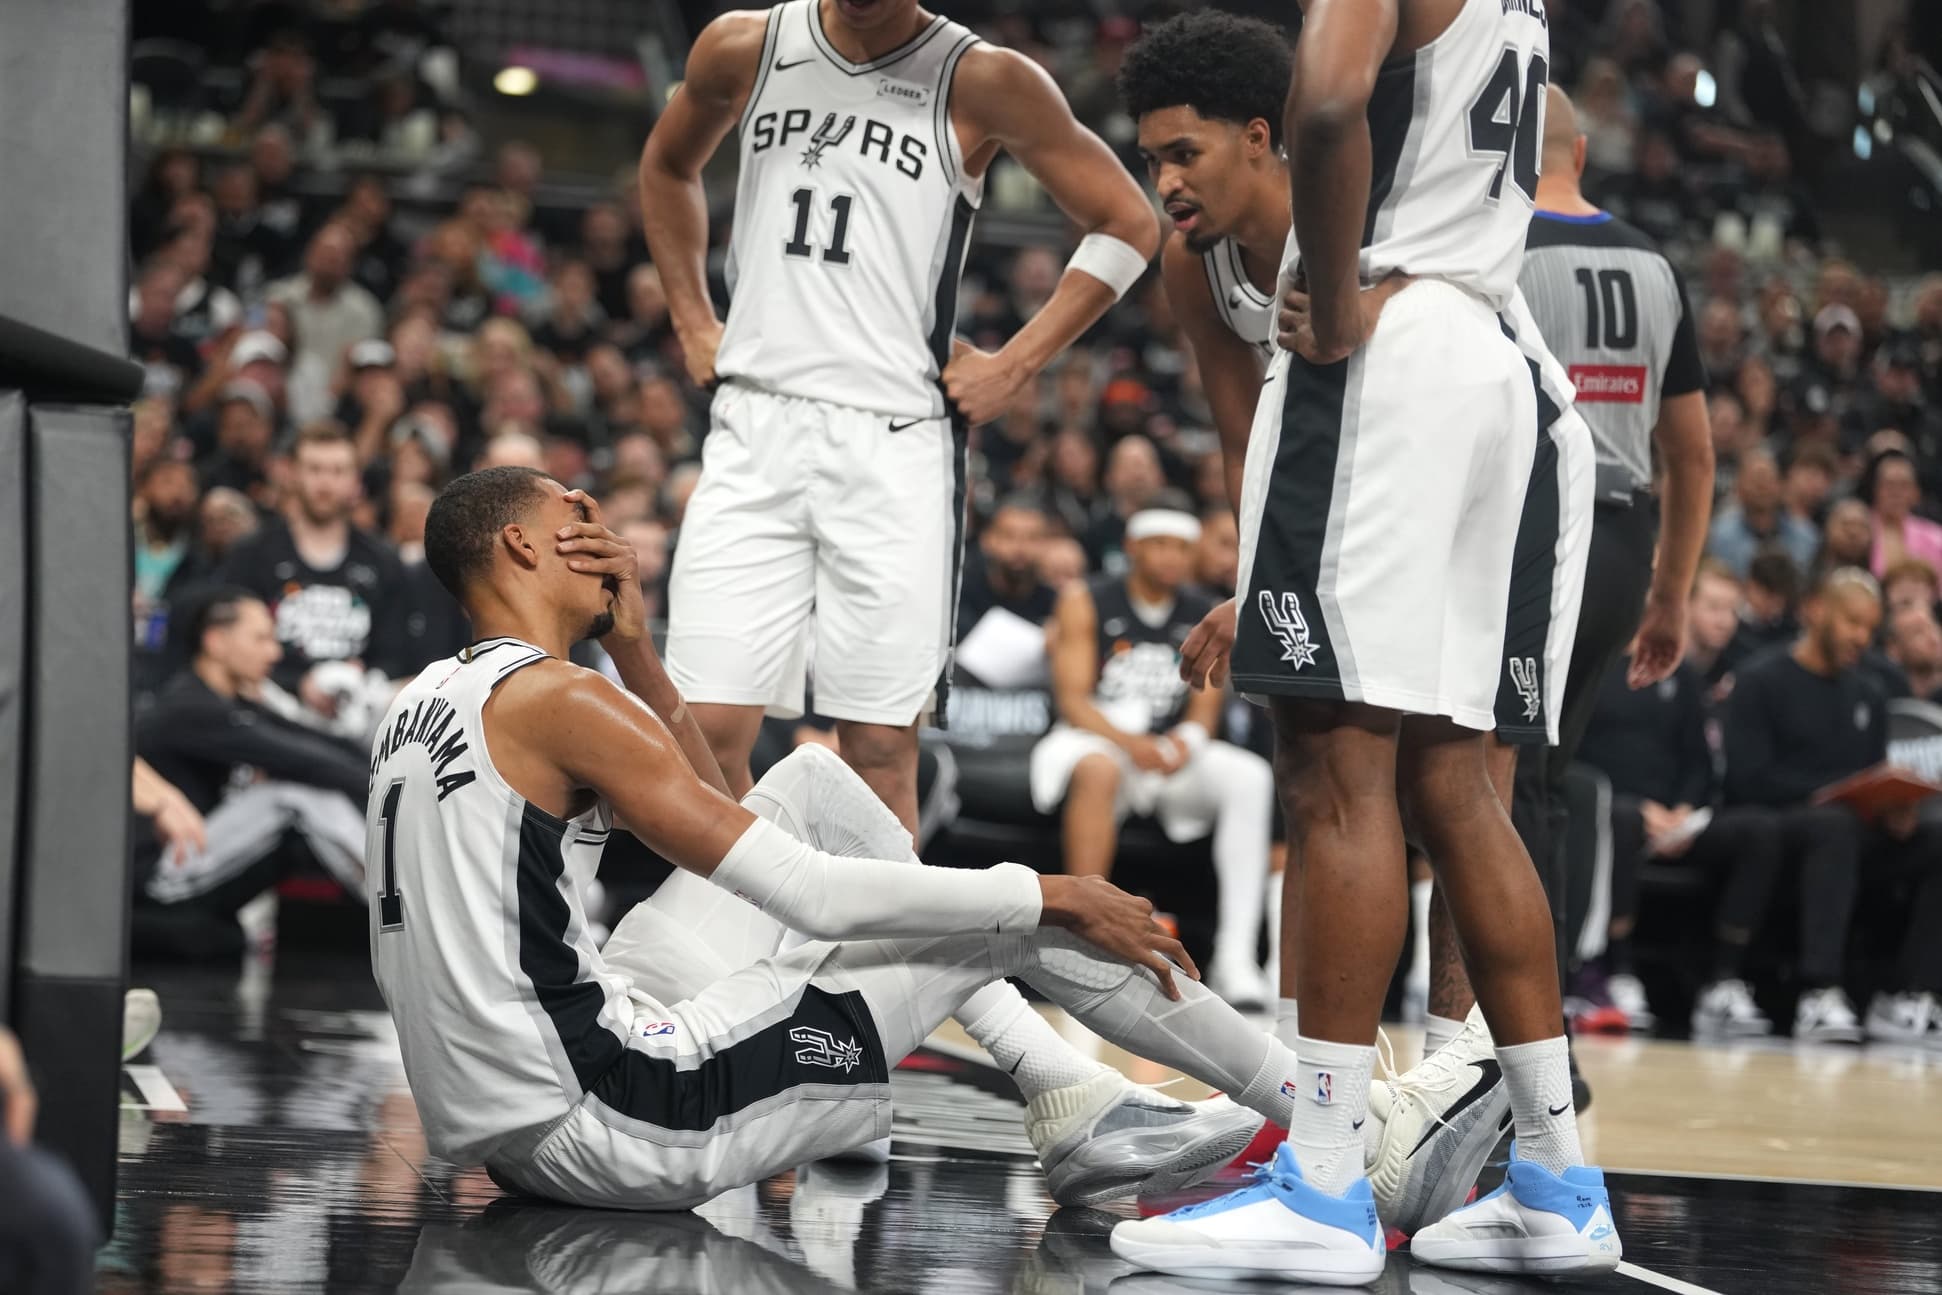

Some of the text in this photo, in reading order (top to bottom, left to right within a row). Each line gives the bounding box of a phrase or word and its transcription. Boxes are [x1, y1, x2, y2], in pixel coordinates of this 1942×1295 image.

[752, 109, 927, 181] SPURS
[784, 187, 853, 266] 11
[1575, 267, 1638, 350] 10
[1573, 372, 1639, 394] Emirates
[377, 778, 404, 932] 1
